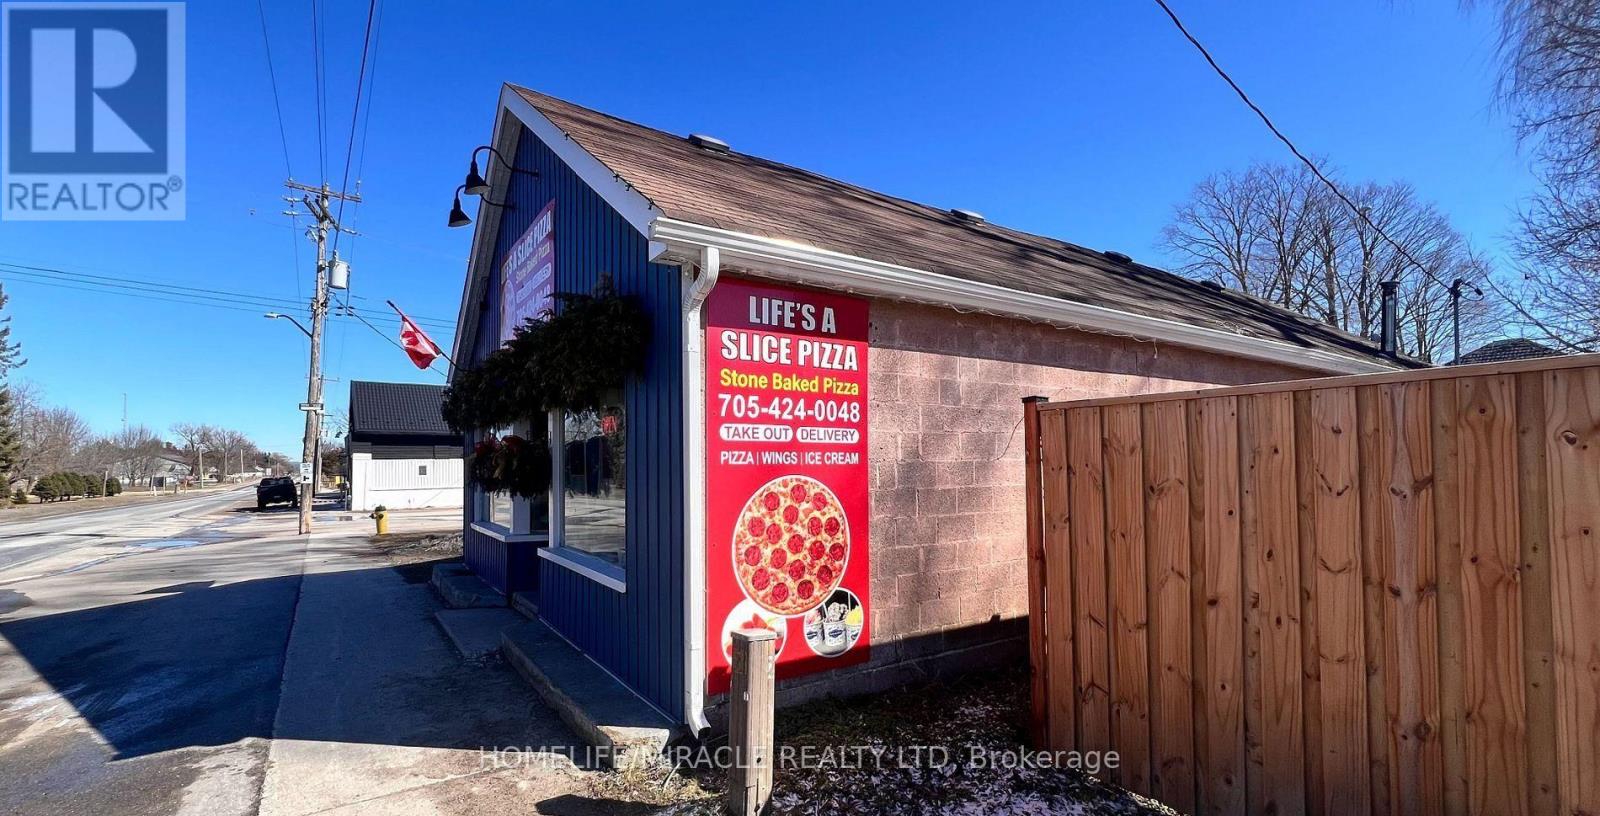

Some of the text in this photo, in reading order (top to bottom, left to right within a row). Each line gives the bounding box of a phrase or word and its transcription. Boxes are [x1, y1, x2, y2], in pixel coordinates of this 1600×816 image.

[534, 210, 551, 248] PIZZA
[750, 295, 837, 334] LIFE'S A
[721, 330, 859, 371] SLICE PIZZA
[720, 368, 859, 395] Stone Baked Pizza
[718, 393, 861, 423] 705-424-0048
[724, 426, 790, 440] TAKE OUT
[801, 428, 856, 442] DELIVERY
[720, 451, 859, 465] PIZZA WINGS ICE CREAM
